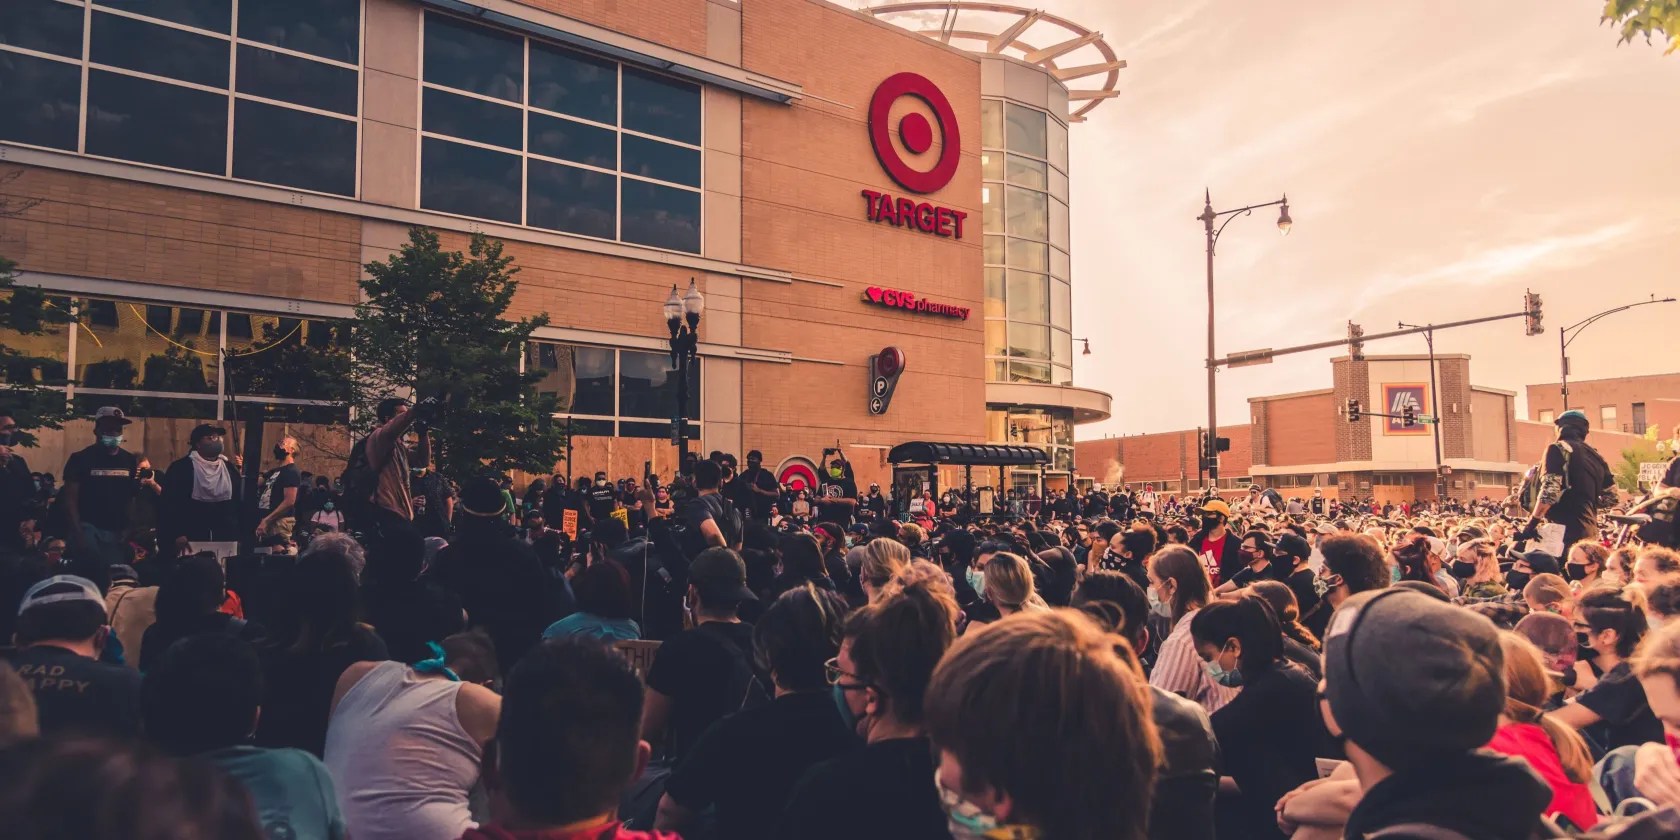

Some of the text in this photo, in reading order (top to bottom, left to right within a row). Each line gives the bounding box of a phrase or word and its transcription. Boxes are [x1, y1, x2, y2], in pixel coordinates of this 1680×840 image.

[862, 189, 967, 239] TARGET
[882, 289, 970, 320] CVS pharmacy
[877, 381, 885, 393] P
